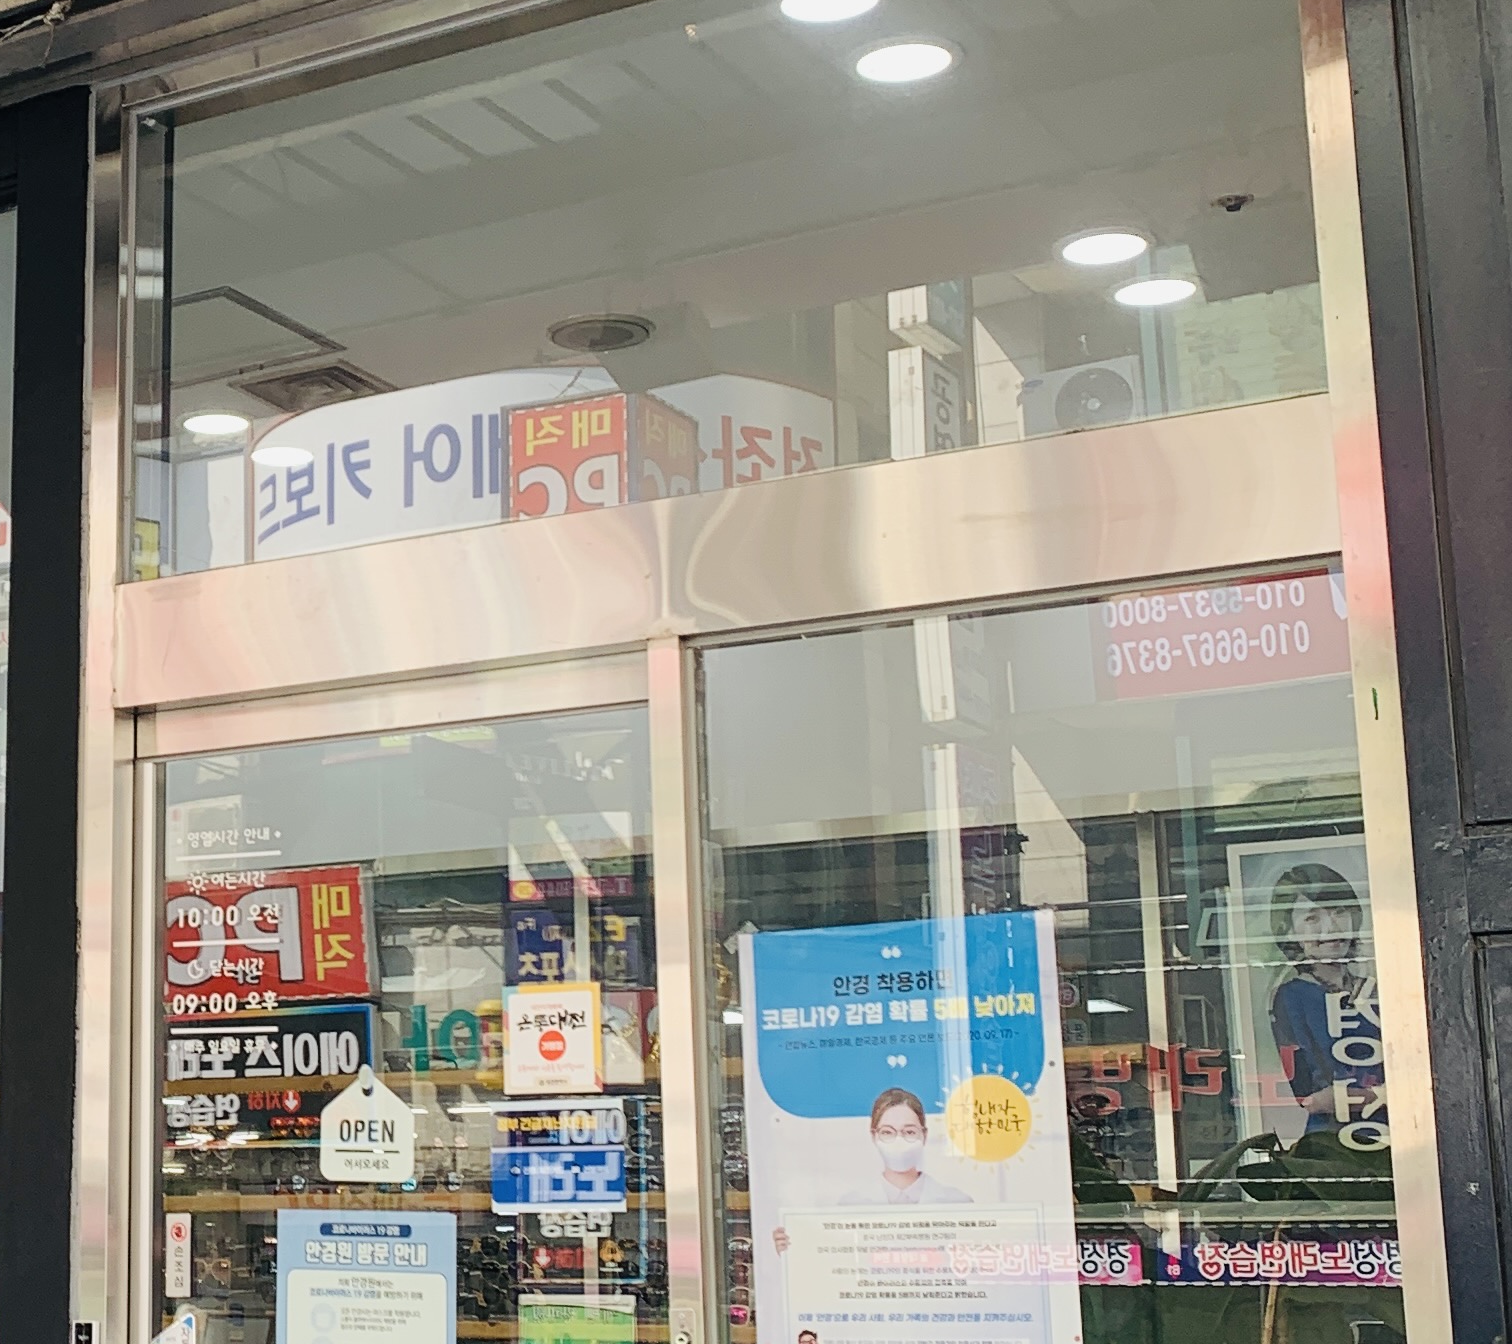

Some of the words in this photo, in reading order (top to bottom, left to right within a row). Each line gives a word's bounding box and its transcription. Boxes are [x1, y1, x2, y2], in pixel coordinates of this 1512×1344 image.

[187, 829, 239, 849] 영업시간
[244, 827, 271, 844] 안내
[177, 905, 239, 928] 10:00
[247, 904, 279, 924] 오전
[209, 958, 265, 978] 닫는시간
[833, 975, 870, 997] 안경
[173, 993, 237, 1015] 09:00
[245, 991, 278, 1011] 오후
[761, 1003, 839, 1031] 코로나19
[845, 1001, 883, 1026] 감염
[889, 998, 929, 1022] 확률
[339, 1118, 395, 1145] OPEN
[343, 1157, 391, 1171] 어서오세요
[305, 1240, 352, 1265] 안경원
[356, 1241, 390, 1265] 방문
[394, 1242, 428, 1267] 안내
